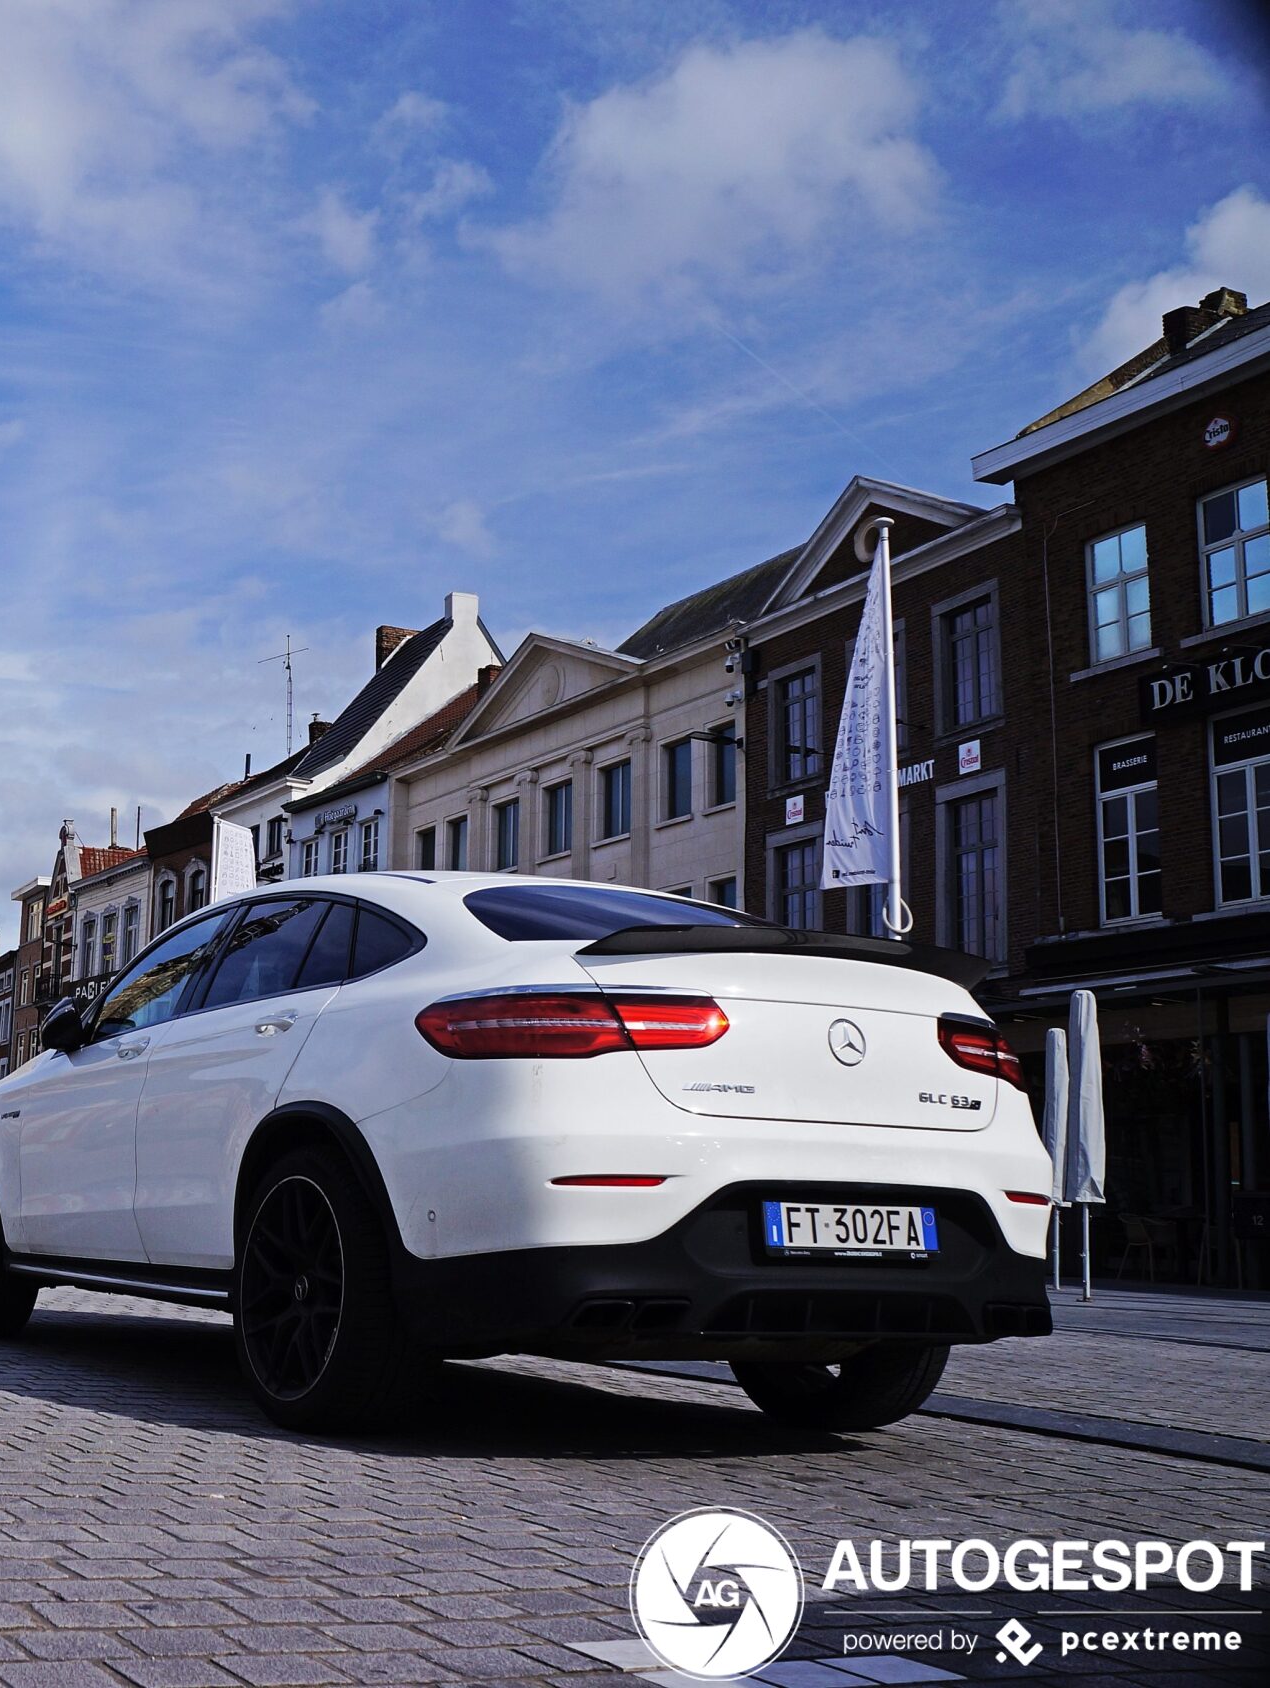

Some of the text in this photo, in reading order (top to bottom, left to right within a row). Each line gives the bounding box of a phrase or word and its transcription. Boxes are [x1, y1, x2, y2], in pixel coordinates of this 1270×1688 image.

[1150, 672, 1193, 710] DE
[897, 759, 935, 788] MARKT
[1112, 754, 1148, 771] BRASSERIE
[711, 1084, 755, 1094] AMG
[786, 1206, 920, 1246] FT 302FA
